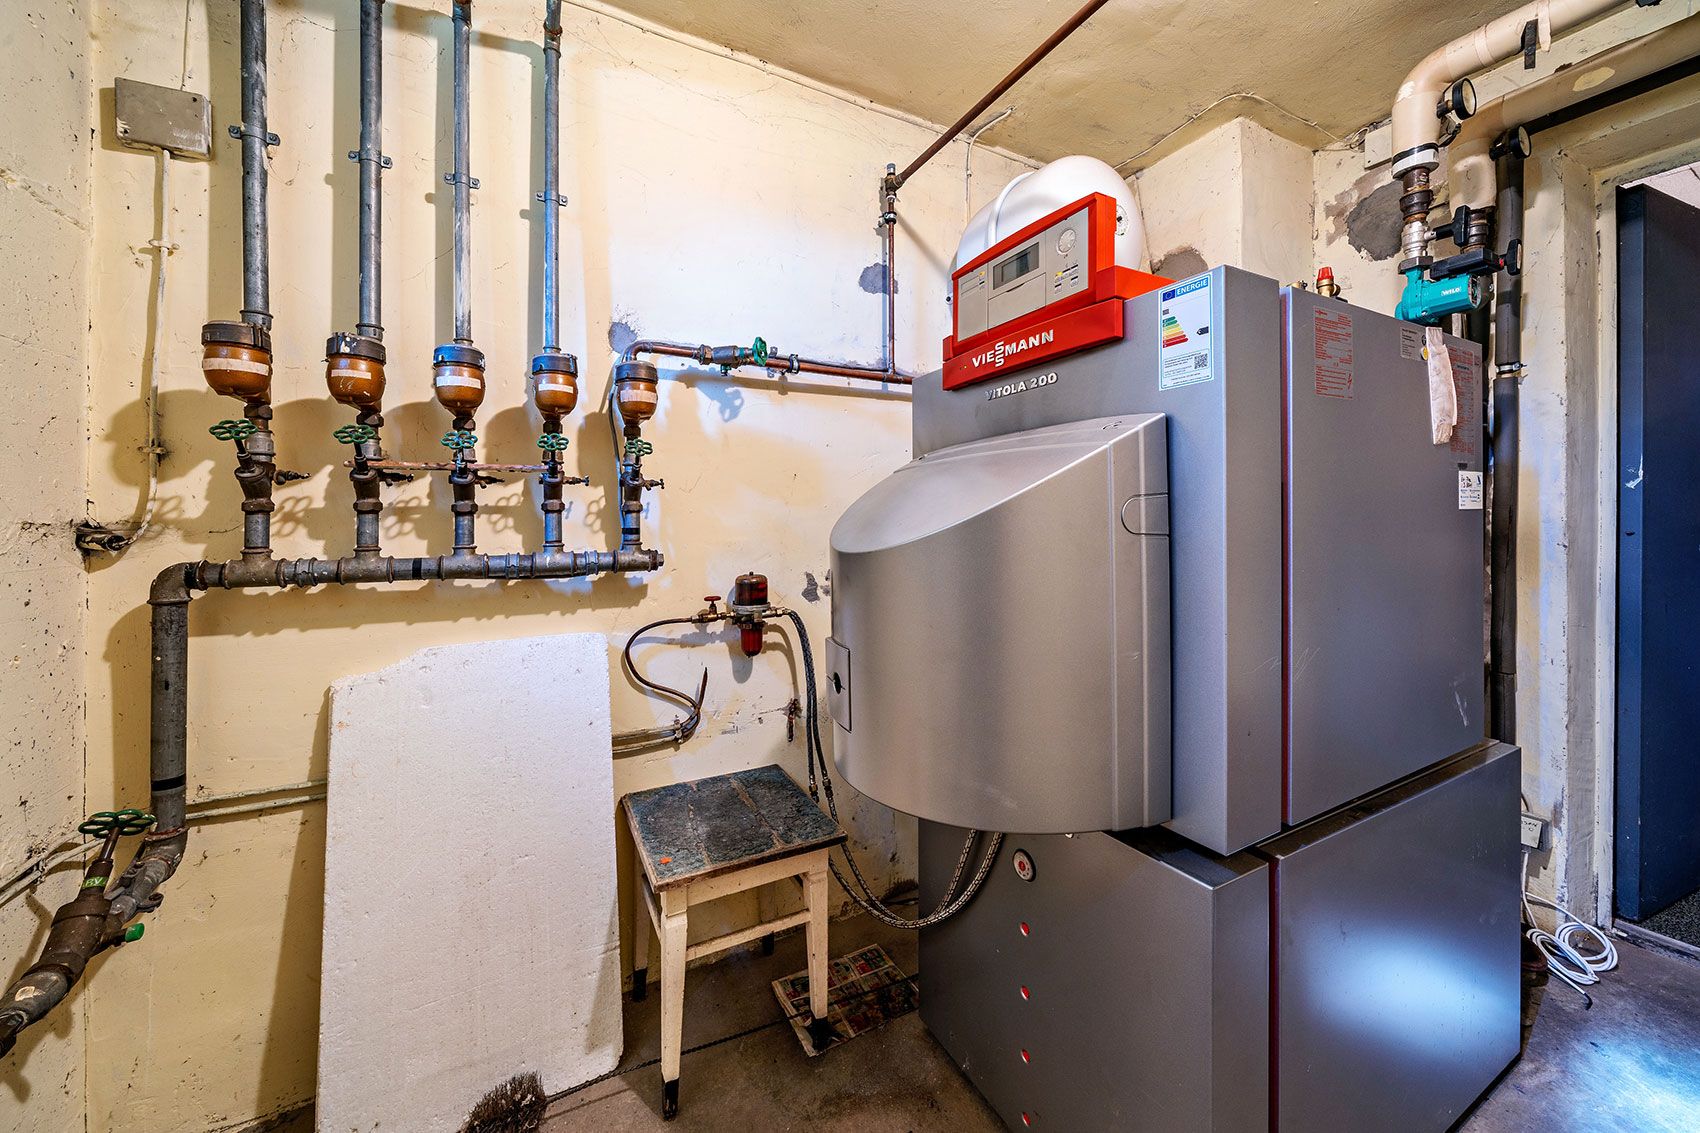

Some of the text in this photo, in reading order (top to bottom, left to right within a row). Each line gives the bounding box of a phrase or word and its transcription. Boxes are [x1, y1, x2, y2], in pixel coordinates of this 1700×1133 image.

[1177, 279, 1208, 295] ENERGIE
[972, 329, 1054, 368] VIESSMANN
[985, 372, 1058, 401] VITOLA 200
